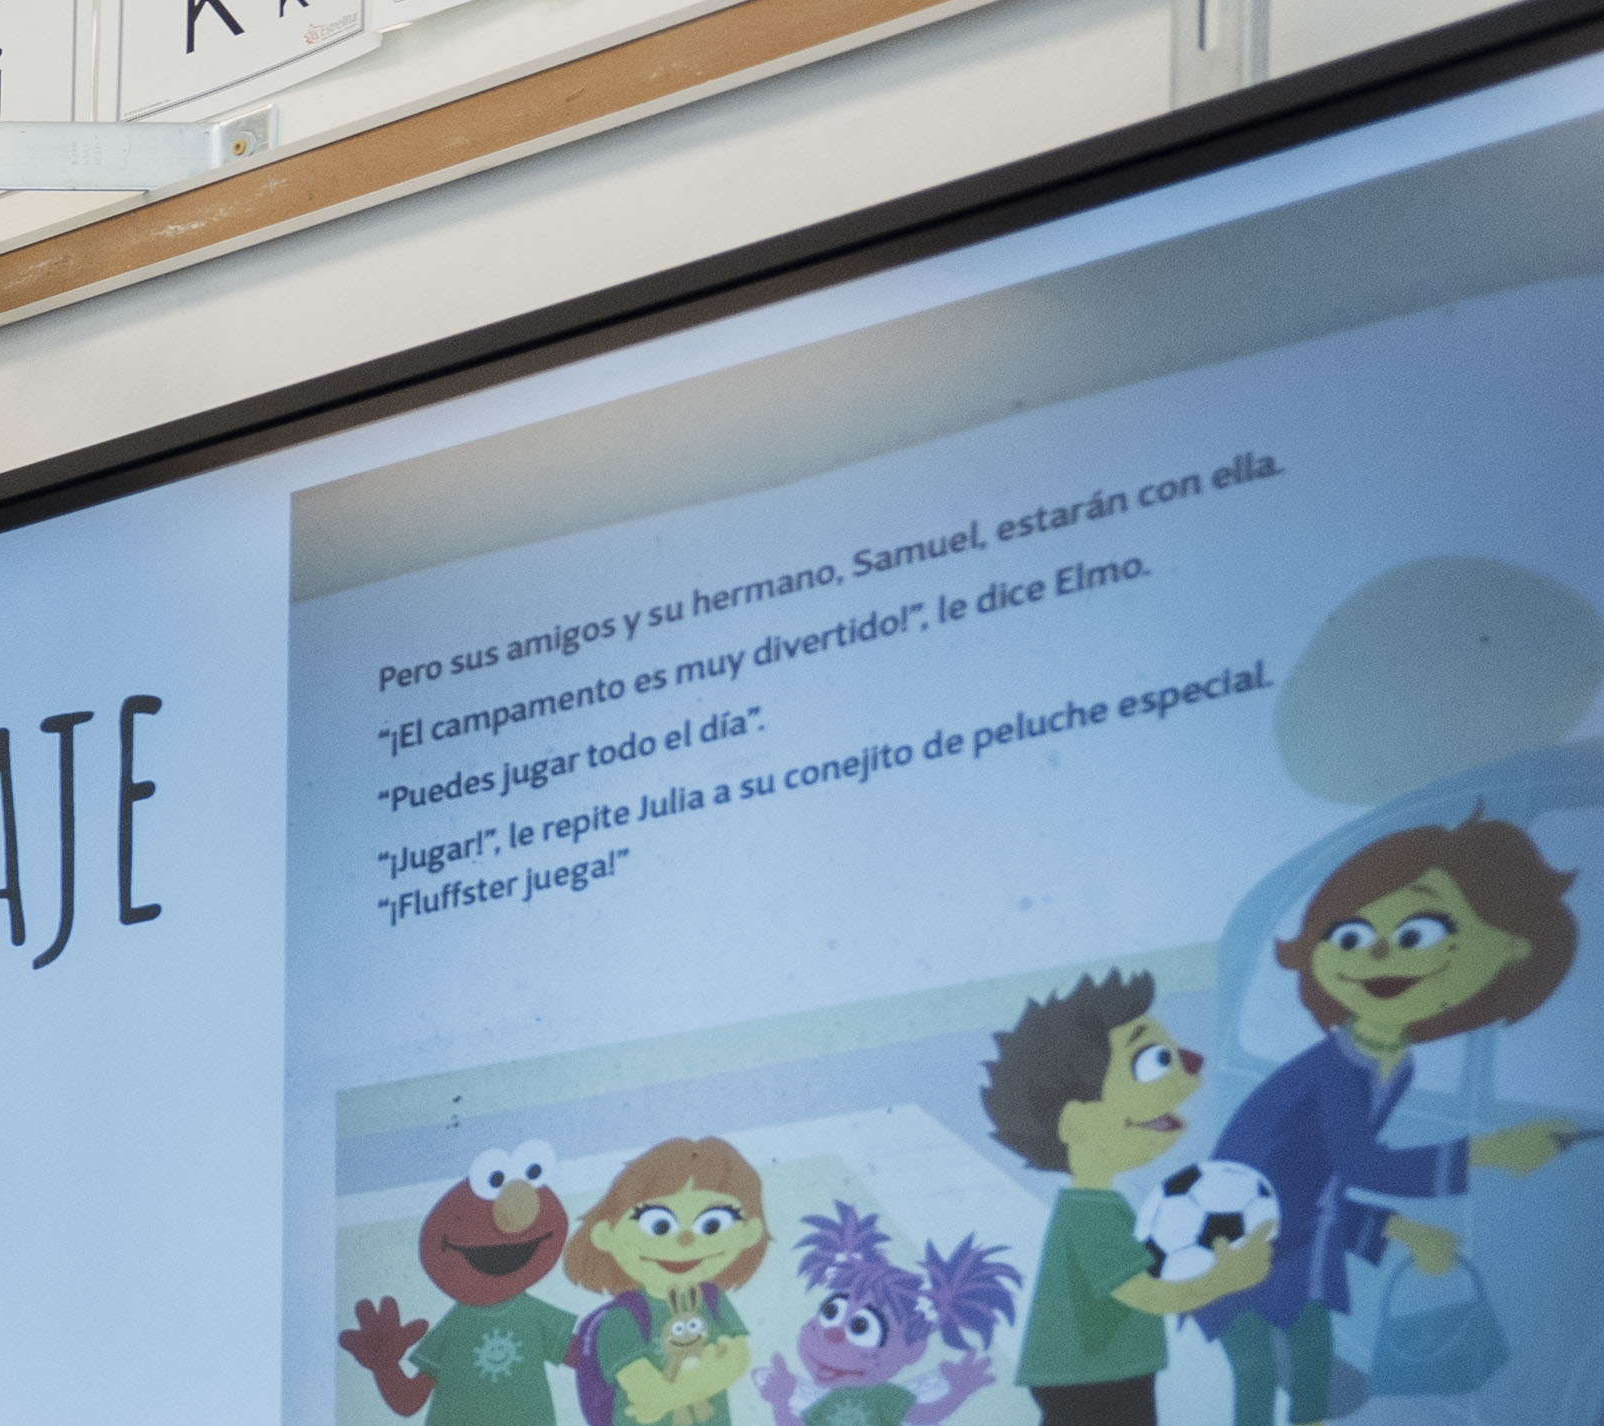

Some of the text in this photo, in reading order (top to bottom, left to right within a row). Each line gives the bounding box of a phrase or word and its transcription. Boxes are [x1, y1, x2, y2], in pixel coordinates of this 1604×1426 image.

[378, 451, 1286, 692] Pero sus amigos y su hermano, Samuel, estarán con ella.
[431, 676, 626, 743] campamento
[634, 667, 668, 696] es
[676, 649, 745, 685] muy
[937, 594, 968, 625] le
[976, 579, 1046, 614] dice
[1054, 553, 1153, 598] Elmo.
[500, 751, 582, 799] jugar
[587, 732, 657, 769] todo
[664, 719, 693, 751] el
[509, 821, 535, 851] le
[542, 800, 631, 844] repite
[637, 783, 705, 823] Julia
[712, 783, 732, 806] a
[739, 773, 776, 801] su
[784, 741, 913, 790] conejito
[922, 728, 965, 763] de
[972, 699, 1109, 760] peluche
[1117, 658, 1274, 720] especial.
